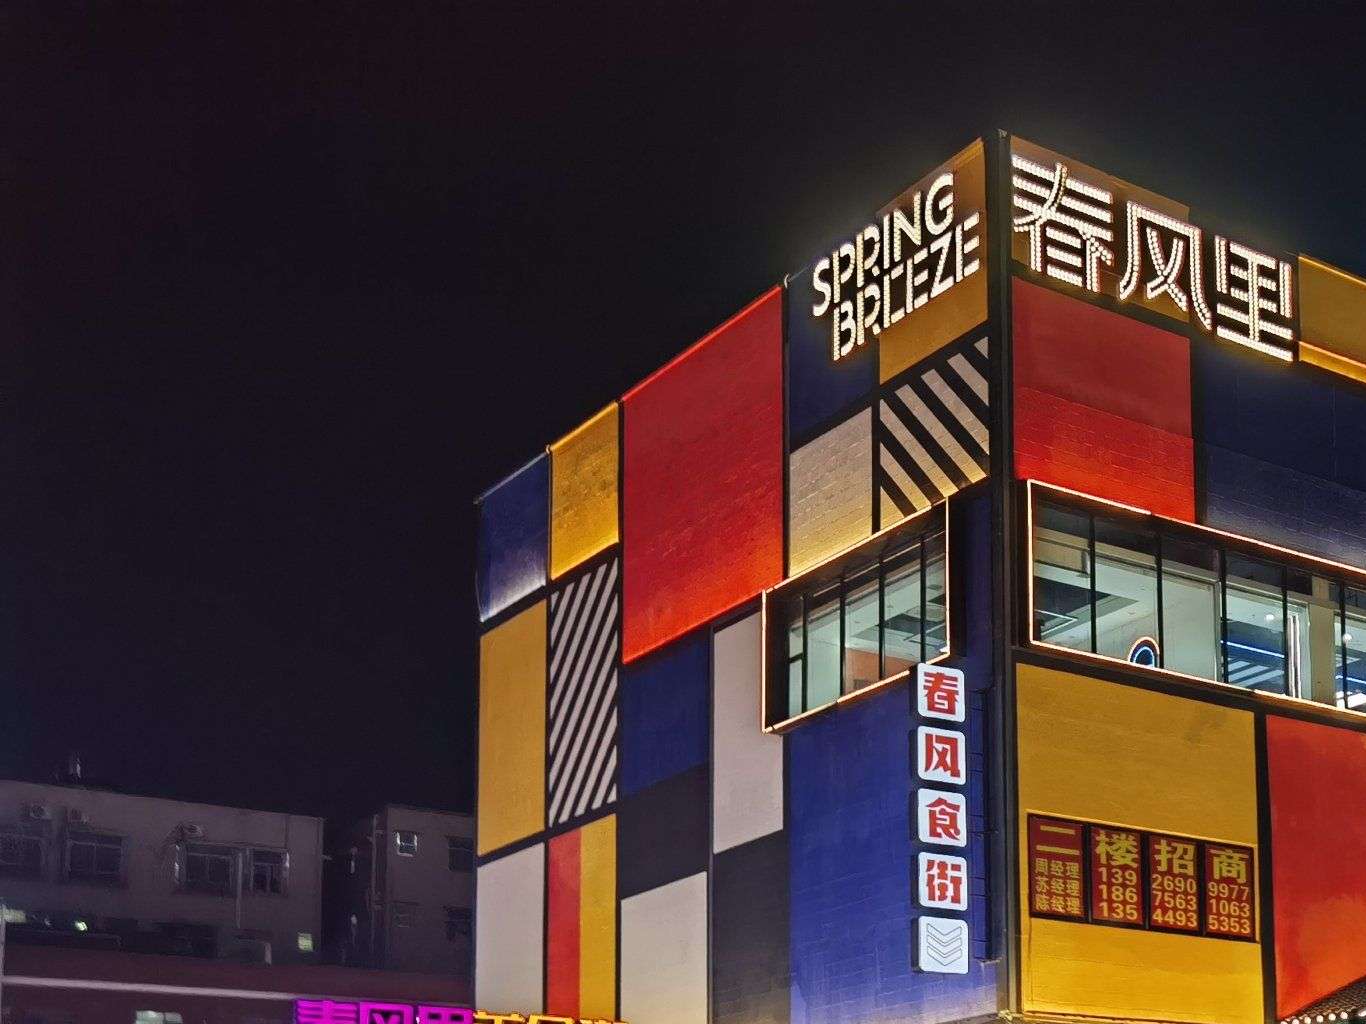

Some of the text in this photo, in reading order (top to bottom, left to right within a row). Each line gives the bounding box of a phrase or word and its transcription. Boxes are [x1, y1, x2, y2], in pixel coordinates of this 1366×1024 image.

[812, 172, 955, 317] SPRING
[1012, 153, 1295, 362] 春风里
[922, 670, 963, 905] 春风食街
[1036, 824, 1251, 885] 二楼招商
[1098, 867, 1138, 887] 139
[1151, 873, 1198, 894] 2690
[1207, 881, 1250, 901] 9977
[1098, 884, 1138, 904] 186
[1152, 890, 1198, 912] 7563
[1208, 897, 1251, 918] 1063
[1098, 901, 1138, 921] 135
[1151, 907, 1198, 928] 4493
[1207, 914, 1251, 935] 5353
